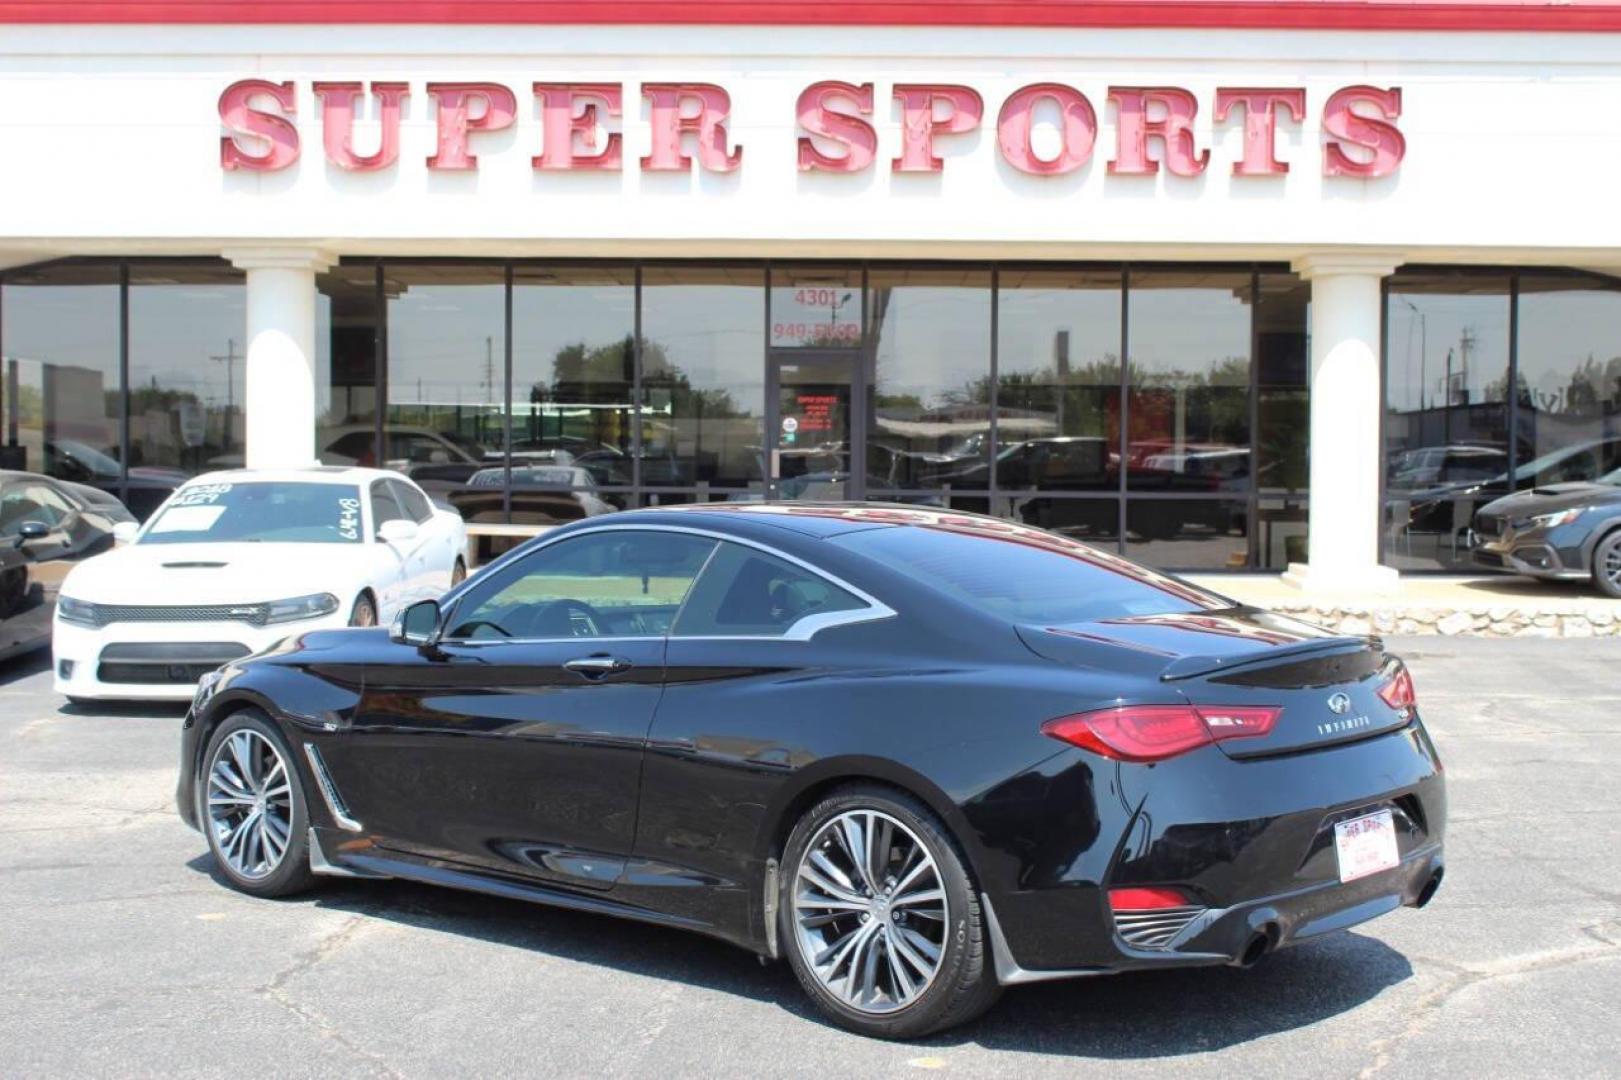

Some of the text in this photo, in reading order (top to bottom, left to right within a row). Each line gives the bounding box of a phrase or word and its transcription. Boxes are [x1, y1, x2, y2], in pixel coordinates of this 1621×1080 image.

[217, 79, 1407, 177] SUPER SPORTS
[795, 289, 838, 306] 4301
